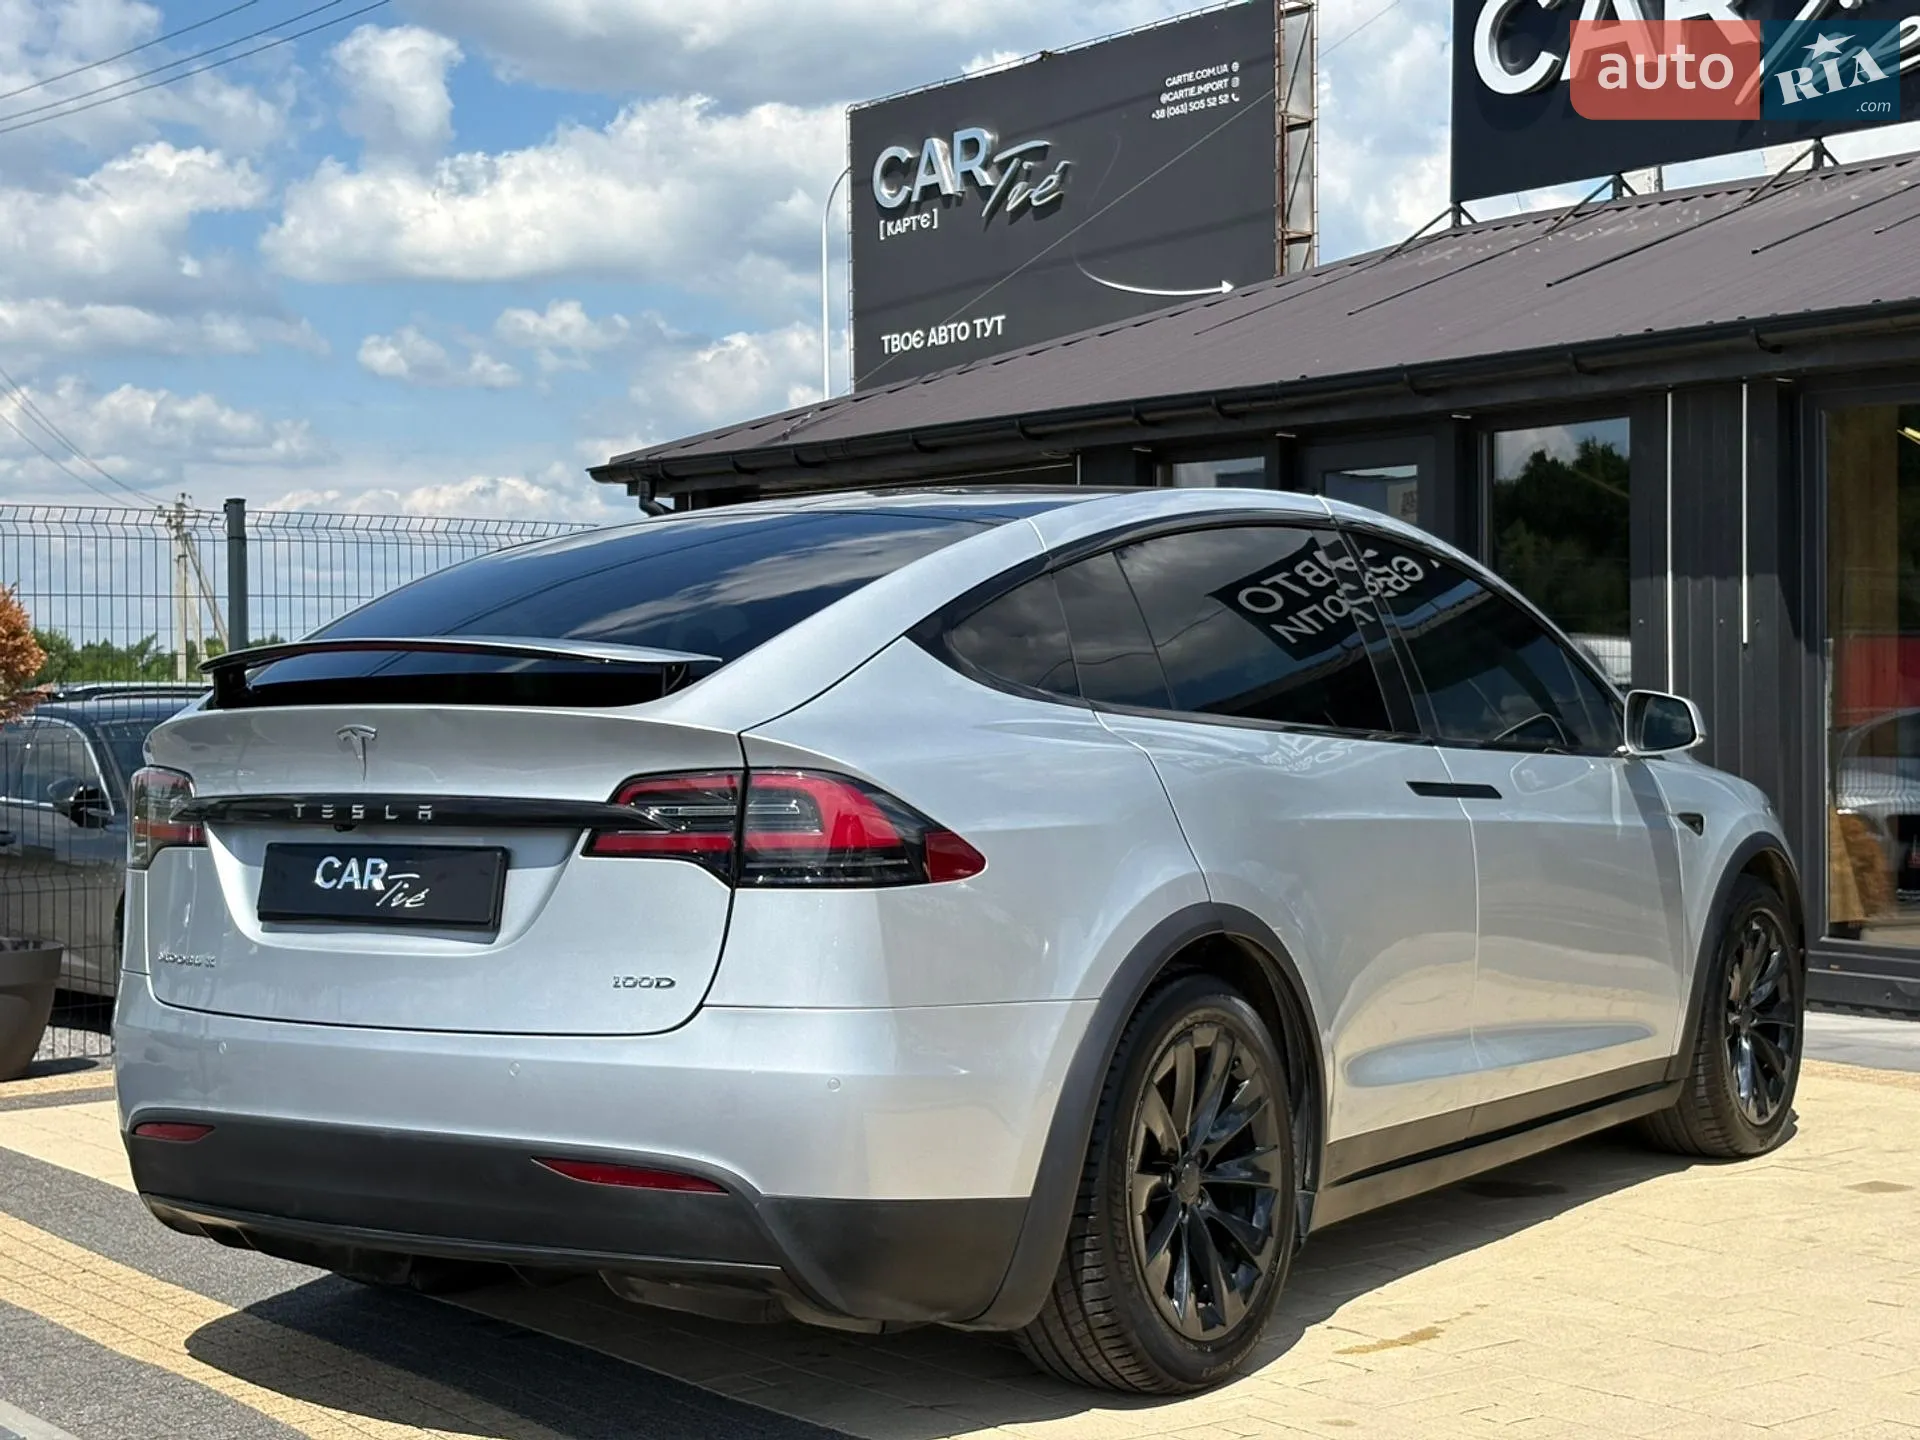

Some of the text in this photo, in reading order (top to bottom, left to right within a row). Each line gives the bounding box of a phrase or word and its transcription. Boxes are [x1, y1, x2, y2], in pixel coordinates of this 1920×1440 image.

[873, 127, 997, 208] CAR
[881, 314, 1006, 354] ТВОЄ АВТО ТУТ
[294, 803, 433, 820] TESLA
[314, 855, 389, 891] CAR
[613, 975, 676, 989] 100D
